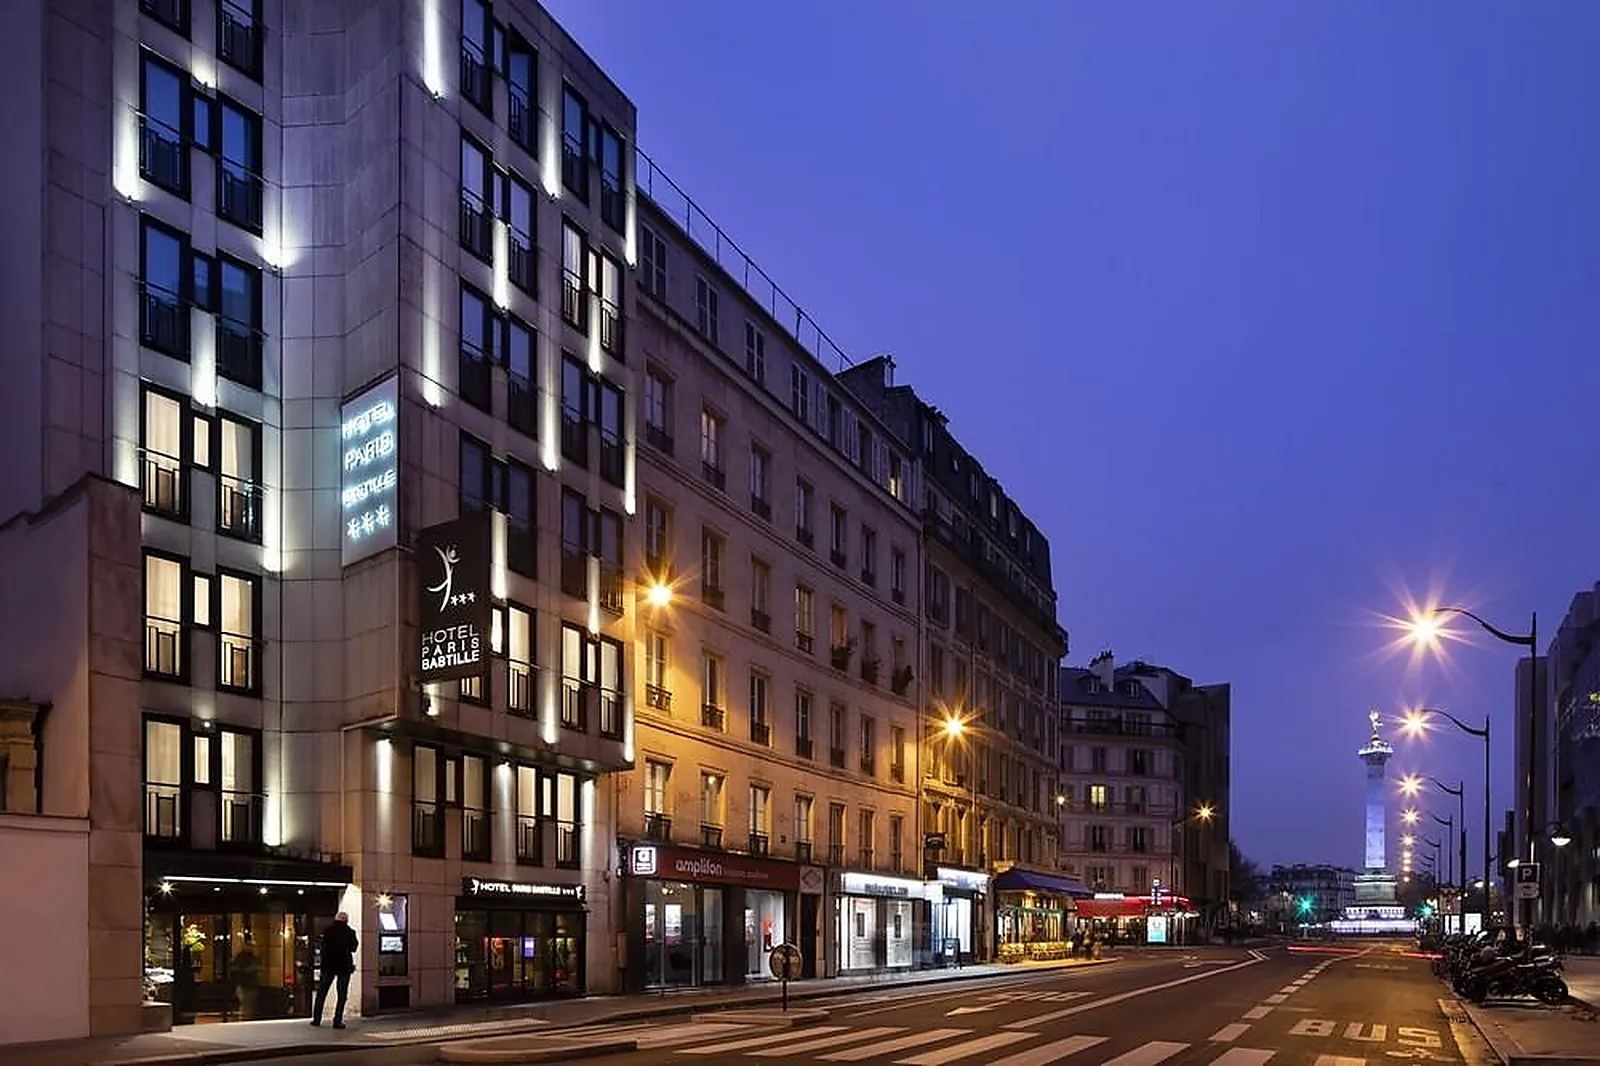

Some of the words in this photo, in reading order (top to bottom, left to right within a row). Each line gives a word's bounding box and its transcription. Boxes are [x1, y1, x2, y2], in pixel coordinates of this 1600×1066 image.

[342, 402, 395, 438] HOTEL
[344, 432, 394, 470] PARIS
[421, 624, 479, 646] HOTEL
[421, 637, 480, 659] PARIS
[421, 649, 480, 670] BASTILLE
[676, 856, 723, 876] amplifon
[1522, 868, 1532, 880] P
[480, 883, 511, 893] HOTEL
[1288, 1018, 1442, 1048] BUS
